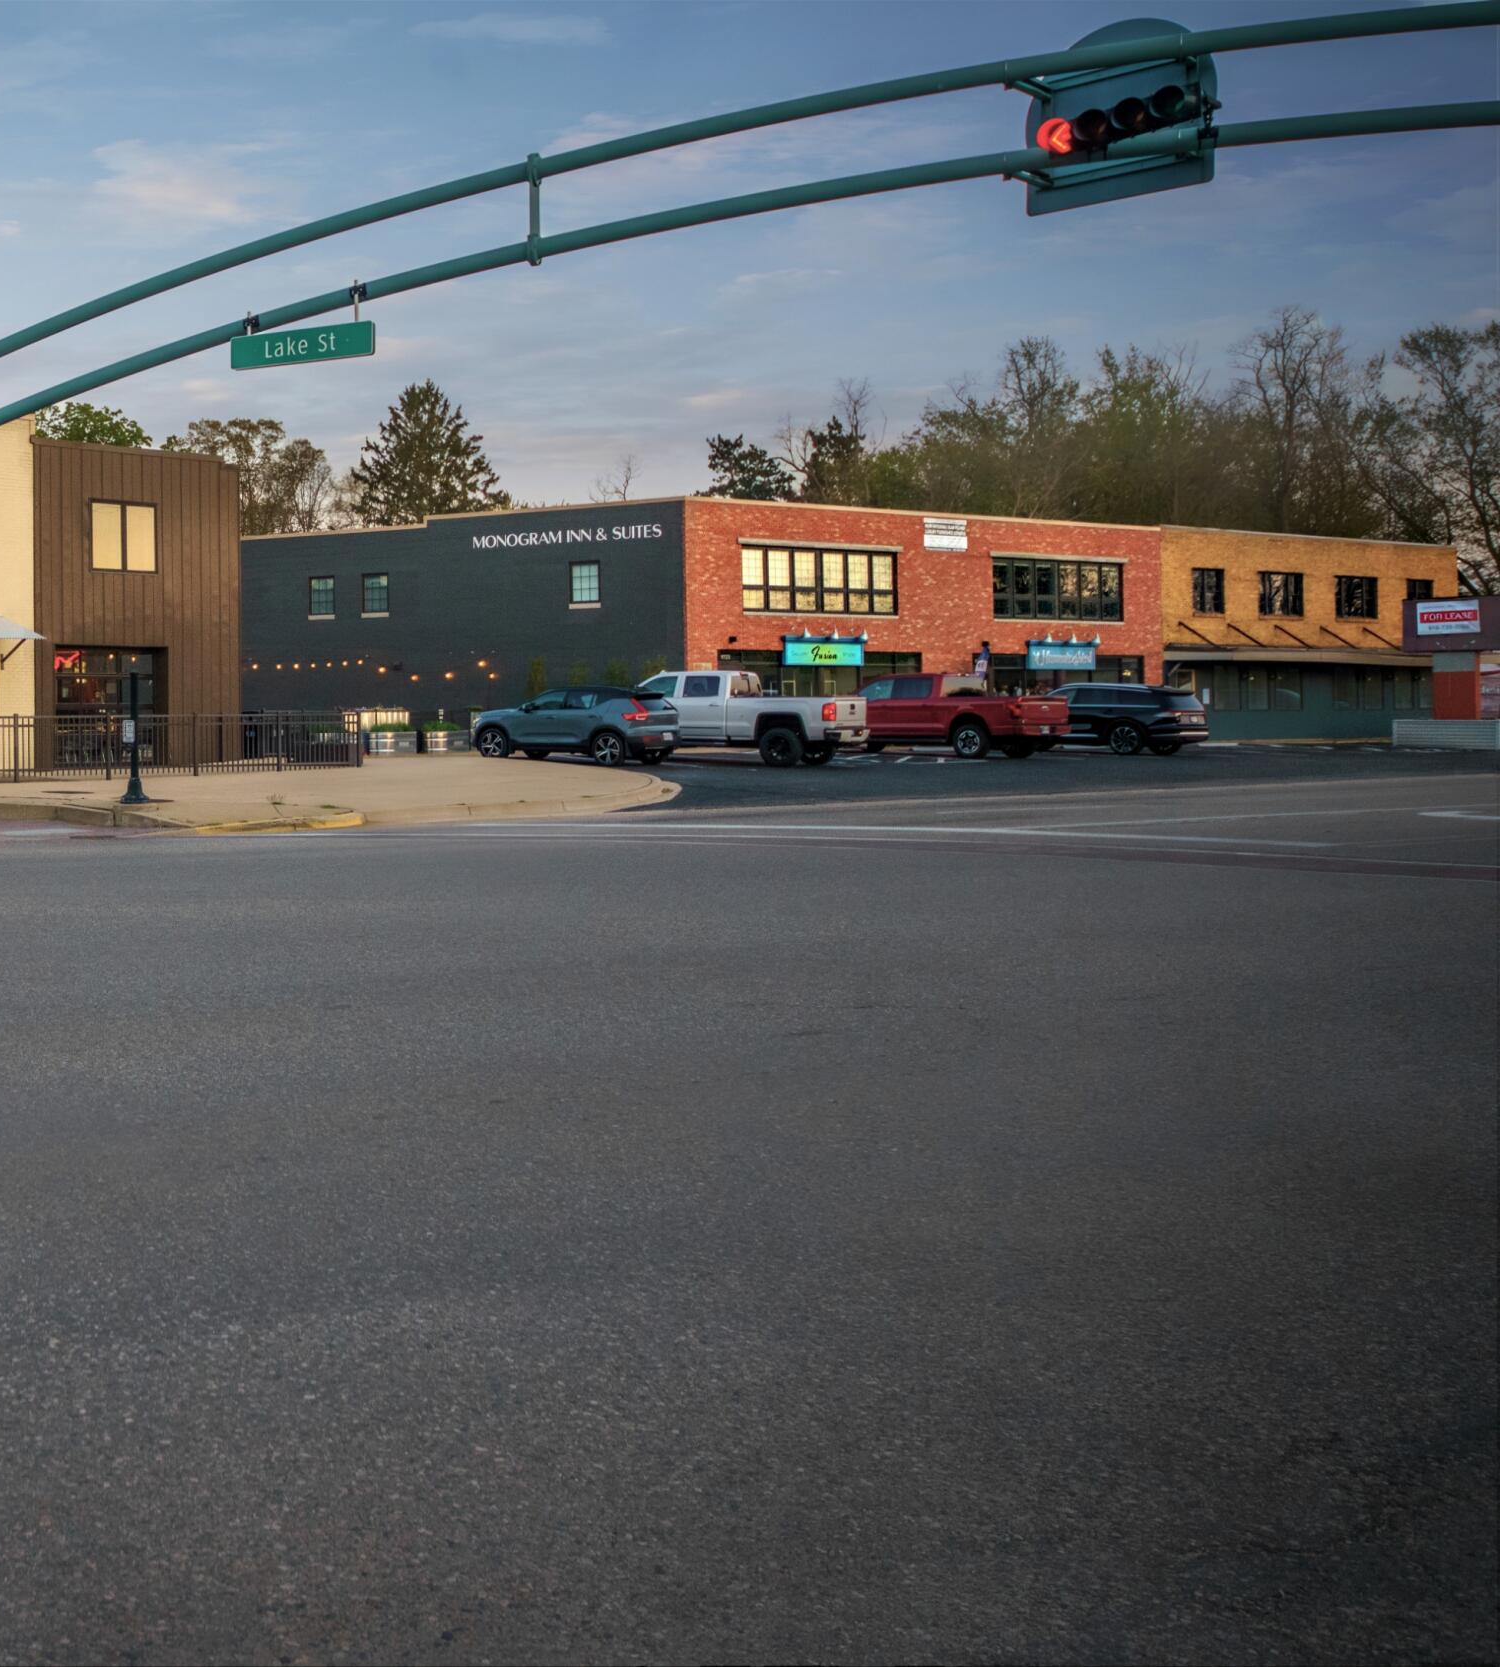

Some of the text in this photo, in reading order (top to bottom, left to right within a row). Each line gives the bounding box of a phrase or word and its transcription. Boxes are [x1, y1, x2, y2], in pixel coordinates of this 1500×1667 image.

[264, 332, 337, 359] Lake St
[472, 523, 662, 549] MONOGRAM INN & SUITES
[1444, 610, 1474, 620] LEASE
[811, 645, 837, 662] Fusion
